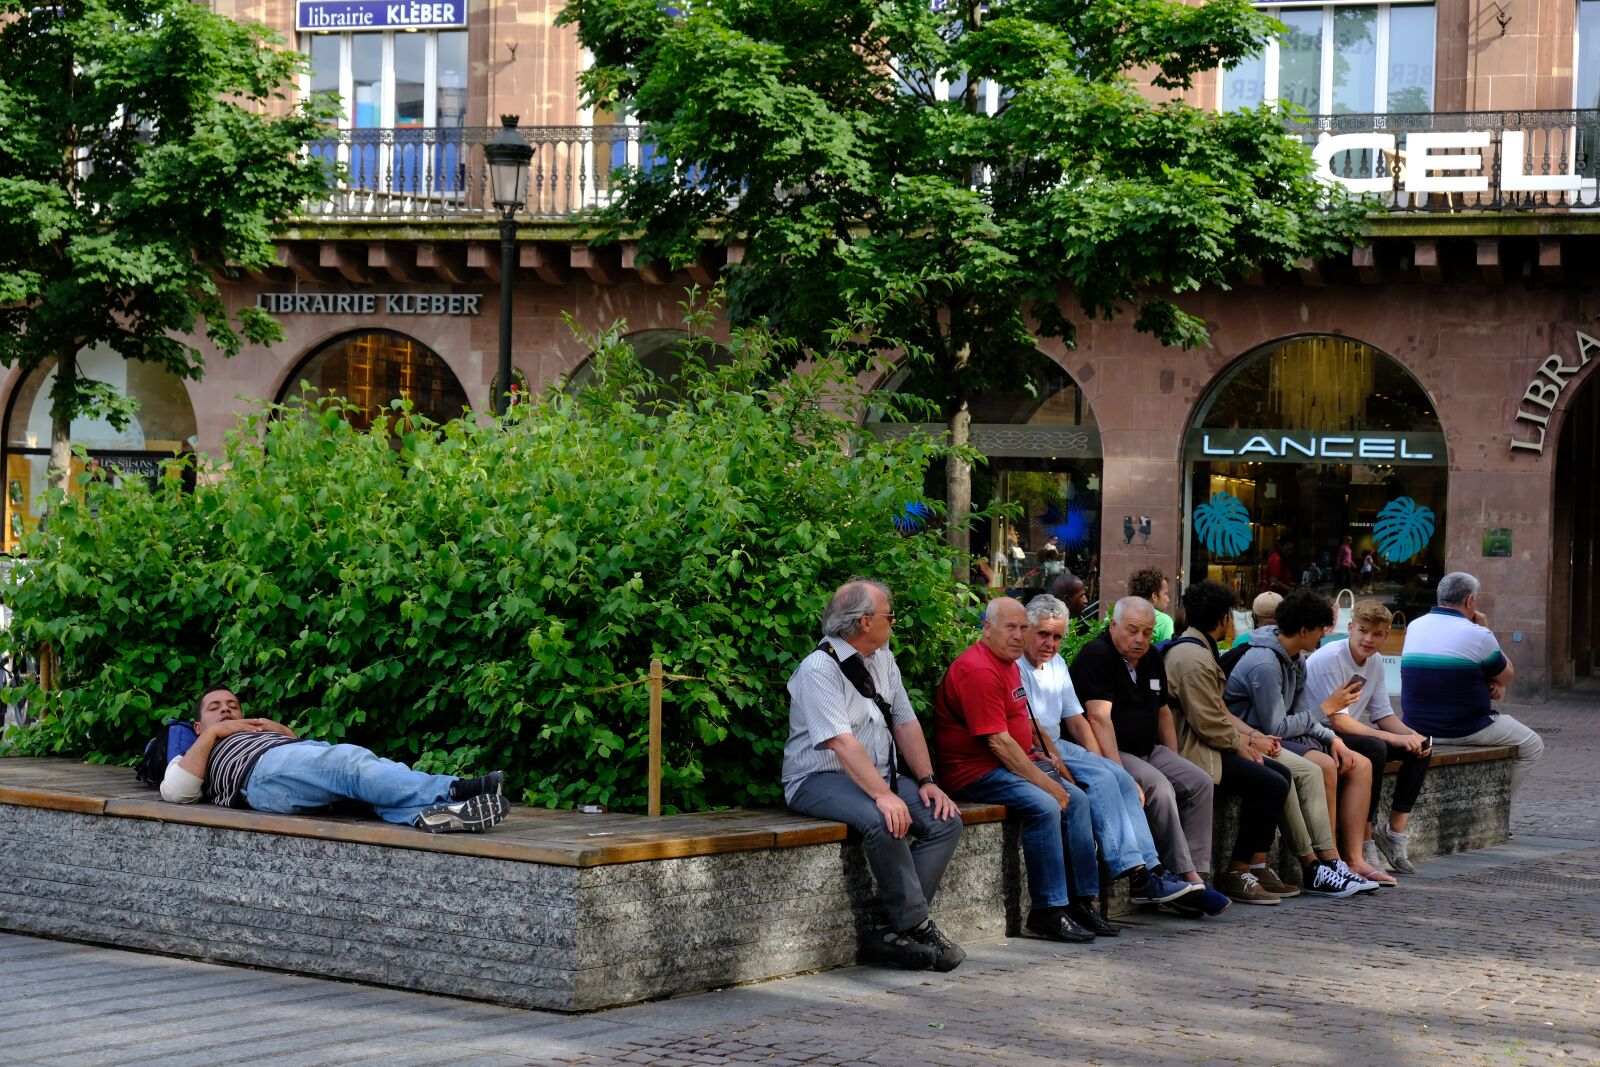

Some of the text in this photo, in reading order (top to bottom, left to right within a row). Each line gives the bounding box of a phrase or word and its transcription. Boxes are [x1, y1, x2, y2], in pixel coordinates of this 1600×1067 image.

[308, 7, 373, 26] librairie
[1285, 131, 1582, 192] CEL
[256, 293, 479, 315] LIBRAIRIE KLEBER
[1509, 314, 1600, 456] LIBRA
[1203, 434, 1434, 459] LANCEL
